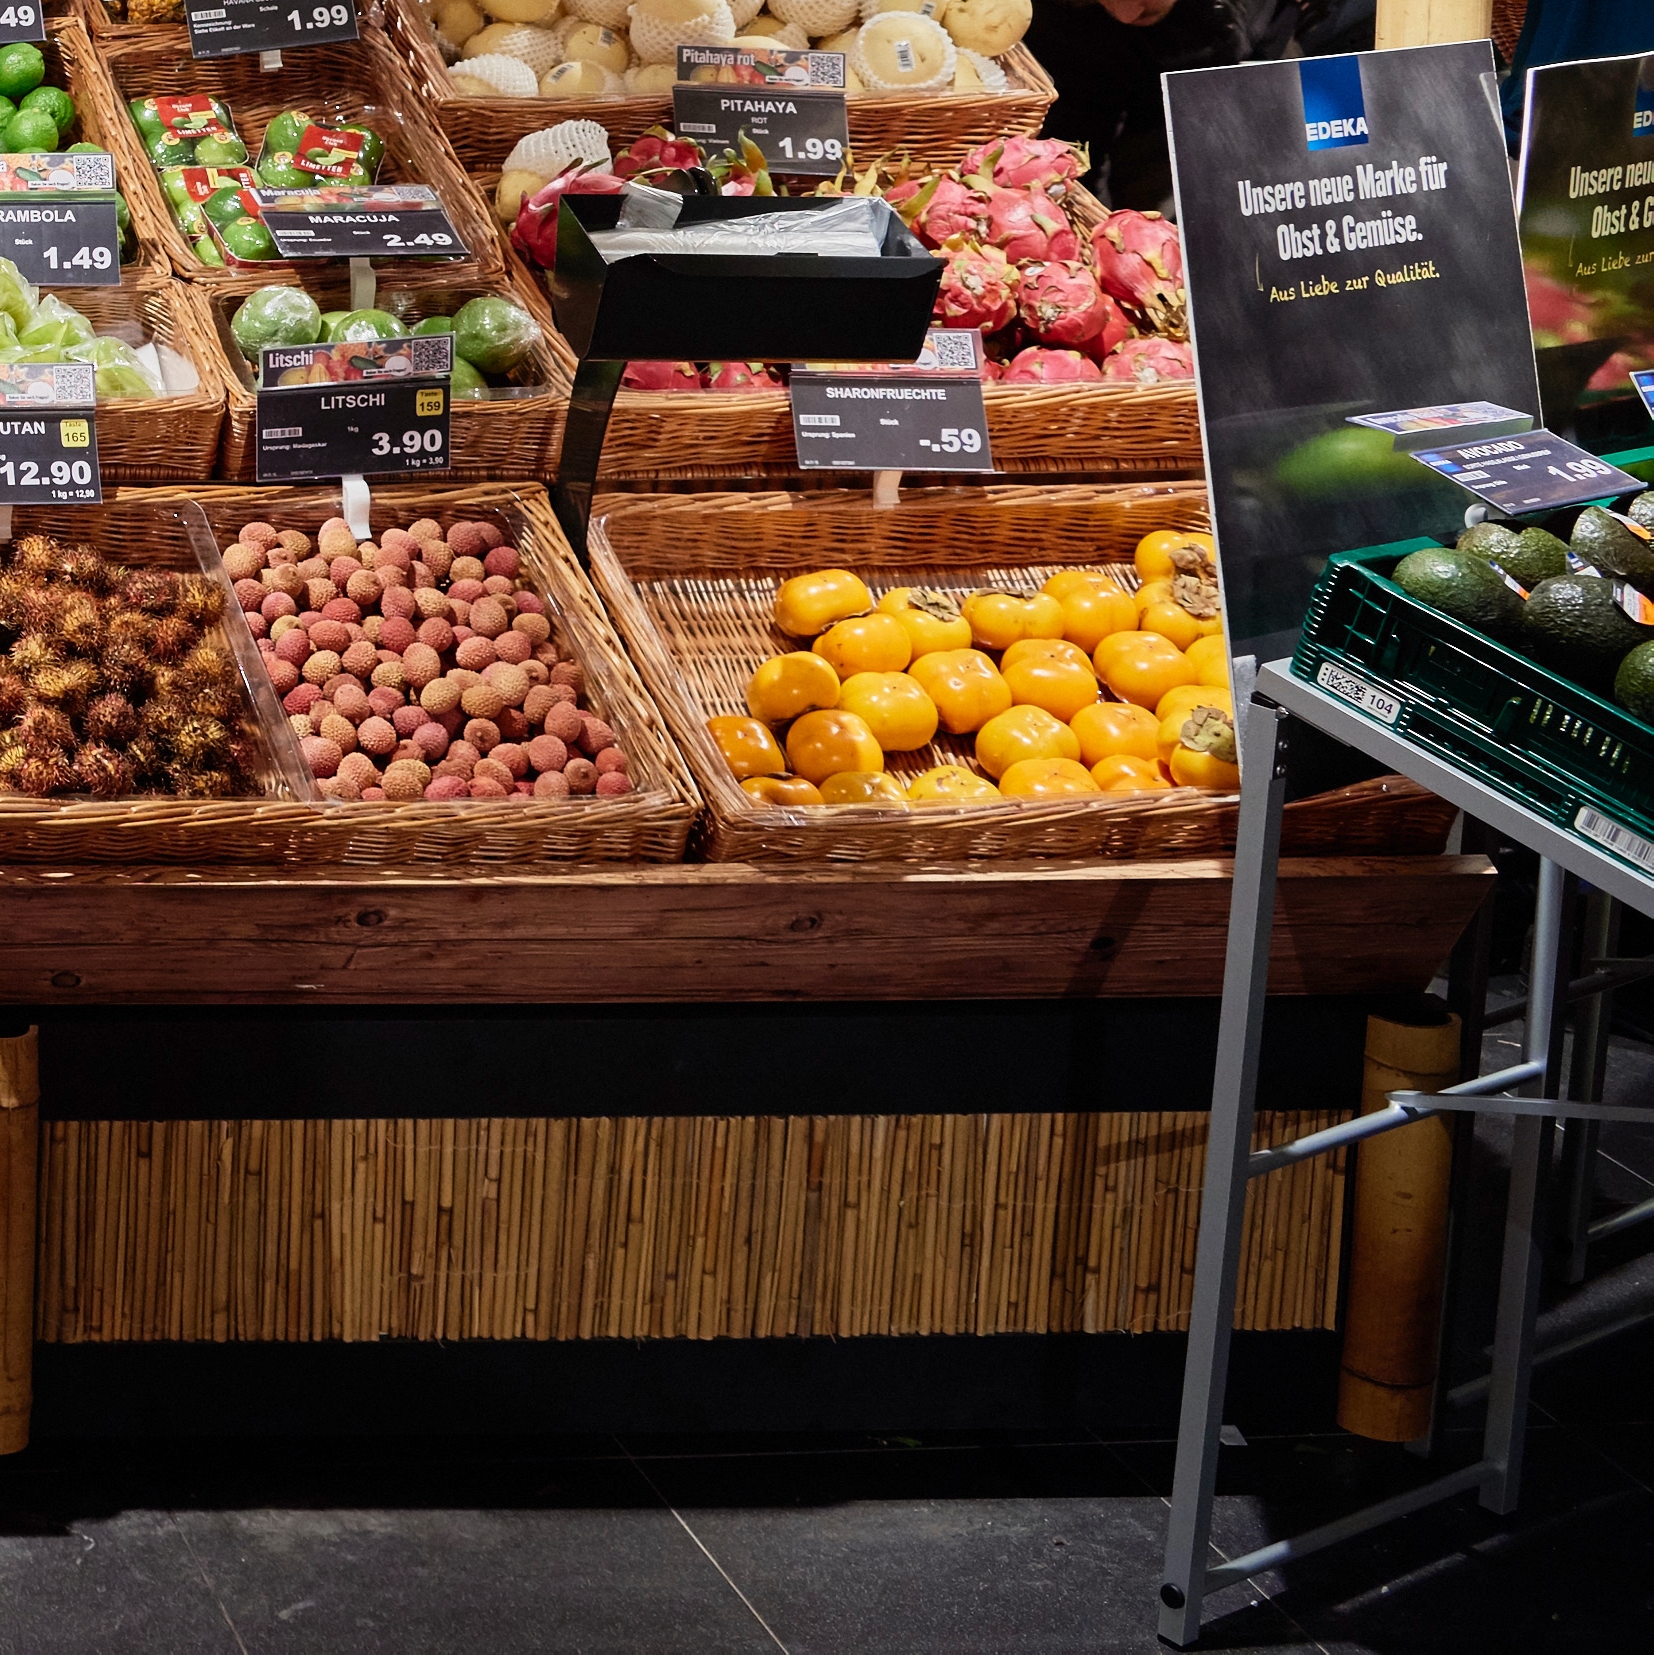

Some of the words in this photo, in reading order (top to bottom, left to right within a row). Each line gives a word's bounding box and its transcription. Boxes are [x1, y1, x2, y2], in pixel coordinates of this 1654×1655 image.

[287, 5, 349, 31] 1.99
[682, 48, 734, 67] Pitahaya
[737, 52, 756, 66] rot
[721, 99, 798, 114] PITAHAYA
[177, 126, 217, 136] LIMETTEN
[1306, 117, 1368, 141] EDEKA
[778, 137, 843, 160] 1.99
[301, 159, 343, 173] LIMETTEN
[1238, 176, 1307, 217] Unsere
[1309, 174, 1355, 206] neue
[1357, 163, 1416, 197] Marke
[1419, 156, 1448, 191] für
[1569, 162, 1624, 199] Unsere
[308, 214, 400, 225] MARACUJA
[1591, 205, 1626, 239] Obst
[382, 232, 453, 247] 2.49
[1276, 223, 1323, 261] Obst
[1325, 222, 1340, 254] &
[1343, 211, 1423, 249] Gemüse.
[43, 247, 112, 271] 1.49
[1576, 258, 1597, 276] Aus
[1600, 255, 1632, 275] Liebe
[1269, 282, 1296, 303] Aus
[1301, 276, 1339, 300] Liebe
[1345, 274, 1370, 291] zur
[1375, 261, 1440, 289] Qualität.
[268, 349, 314, 369] Litschi
[320, 393, 386, 410] LITSCHI
[826, 387, 947, 402] SHARONFRUECHTE
[418, 401, 441, 412] 159
[63, 432, 87, 443] 165
[371, 429, 443, 455] 3.90
[1457, 440, 1525, 460] AVOCADO
[0, 460, 92, 487] 12.90
[1547, 458, 1612, 482] 1.99
